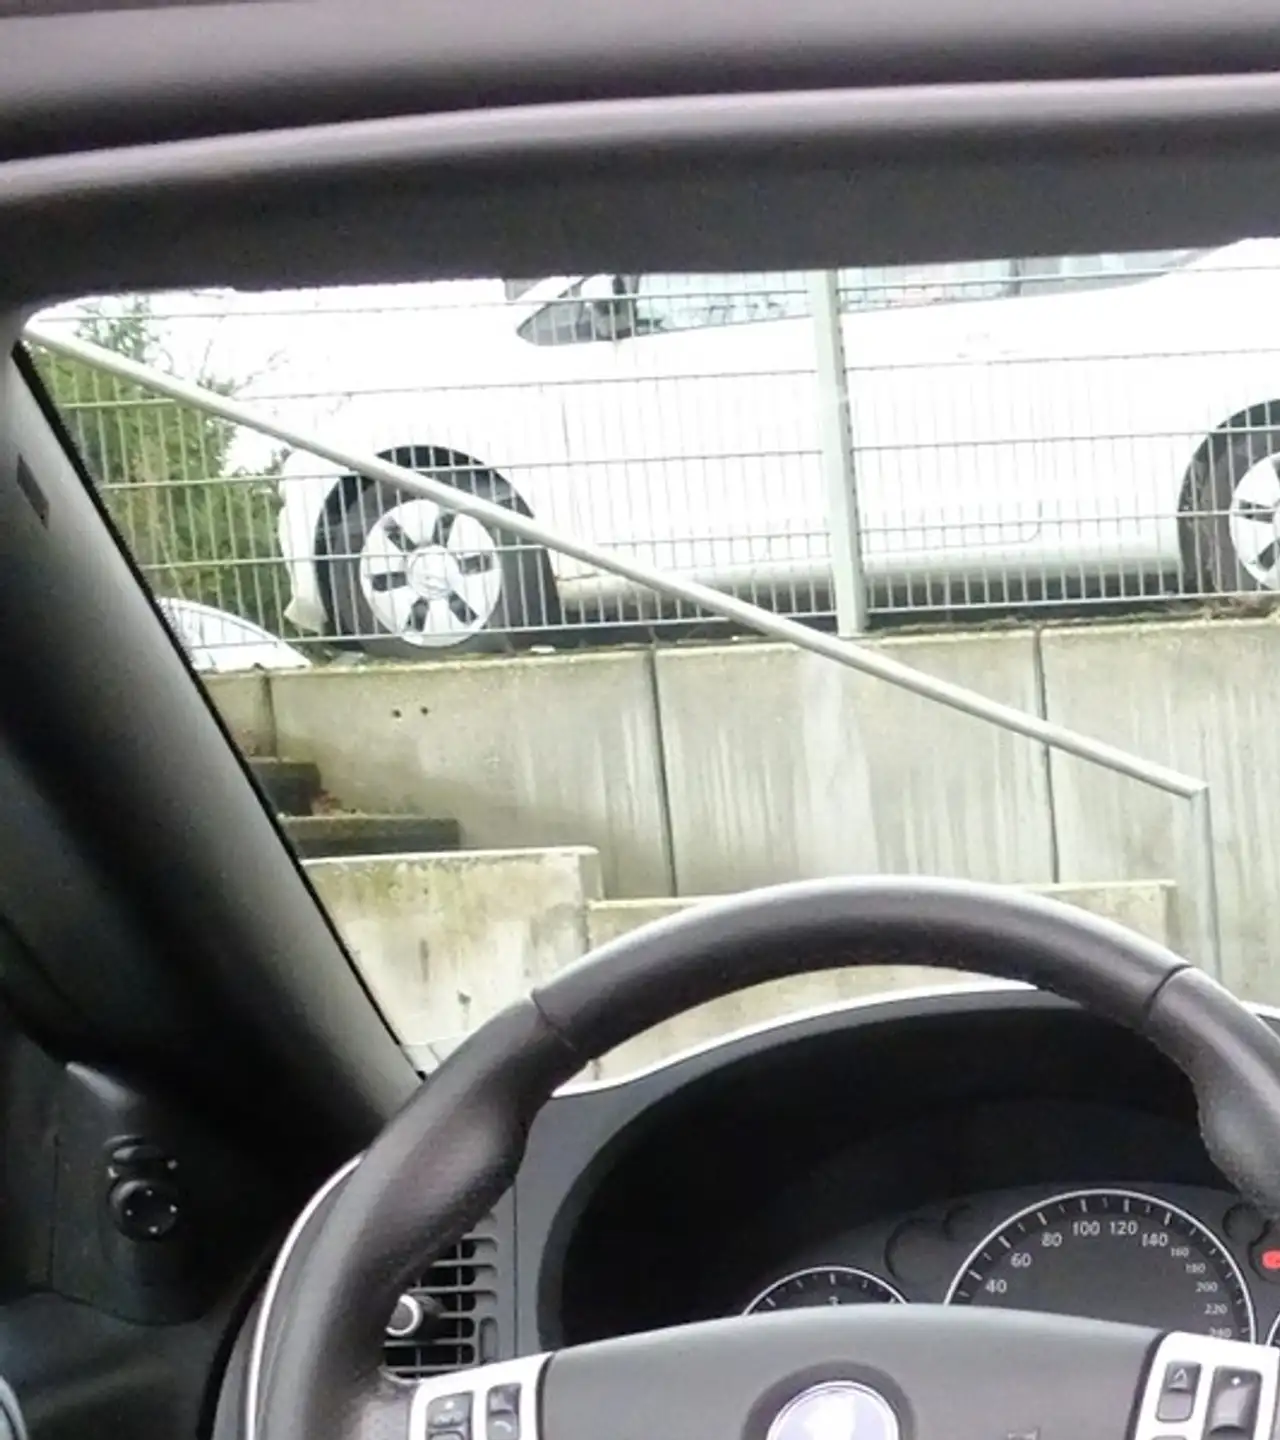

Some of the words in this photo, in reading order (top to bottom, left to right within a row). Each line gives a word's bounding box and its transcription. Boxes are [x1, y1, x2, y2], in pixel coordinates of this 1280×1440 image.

[1073, 1221, 1100, 1236] 100
[1109, 1221, 1138, 1235] 120
[1041, 1232, 1063, 1247] 80
[1142, 1233, 1168, 1247] 140
[1010, 1253, 1031, 1267] 60
[985, 1279, 1008, 1293] 40
